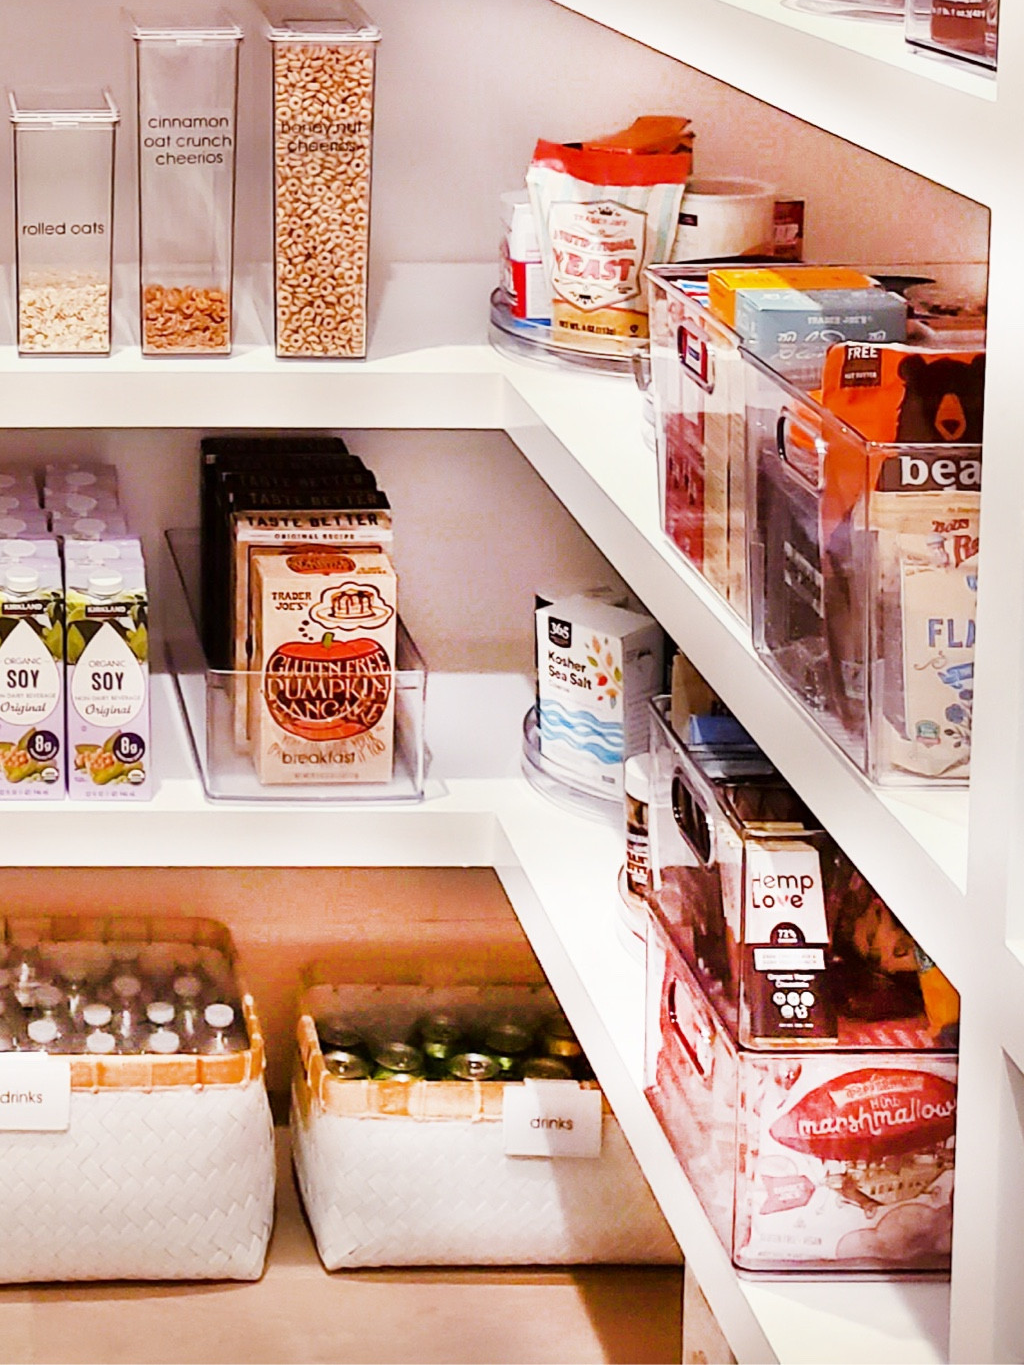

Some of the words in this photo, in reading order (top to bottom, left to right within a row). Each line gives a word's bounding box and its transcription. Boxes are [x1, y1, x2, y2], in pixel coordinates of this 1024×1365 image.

[147, 114, 230, 129] cinnamon
[336, 120, 363, 134] nut
[143, 135, 172, 149] oat
[175, 133, 232, 148] crunch
[155, 151, 224, 165] cheerios
[22, 221, 66, 236] rolled
[70, 222, 105, 235] oats
[552, 246, 635, 282] YEAST
[847, 347, 879, 361] FREE
[246, 515, 303, 528] TASTE
[309, 513, 379, 528] BETTER
[271, 591, 312, 601] TRADER
[4, 603, 43, 611] KIRKLAND
[275, 601, 304, 611] JOE'S
[4, 657, 42, 665] ORGANIC
[88, 660, 126, 668] ORGANIC
[268, 653, 344, 676] GLUTEN
[345, 650, 390, 675] FREE
[547, 650, 587, 673] Kosher
[6, 669, 40, 689] SOY
[91, 672, 124, 692] SOY
[548, 664, 568, 683] Sea
[570, 673, 593, 691] Salt
[267, 676, 390, 700] PUMPKIN
[0, 701, 46, 715] Original
[84, 704, 130, 718] Original
[34, 734, 53, 753] 8g
[118, 736, 138, 756] 8g
[281, 751, 356, 765] breakfast
[751, 872, 814, 895] Hemp
[751, 893, 804, 909] Love
[530, 1115, 574, 1131] drinks
